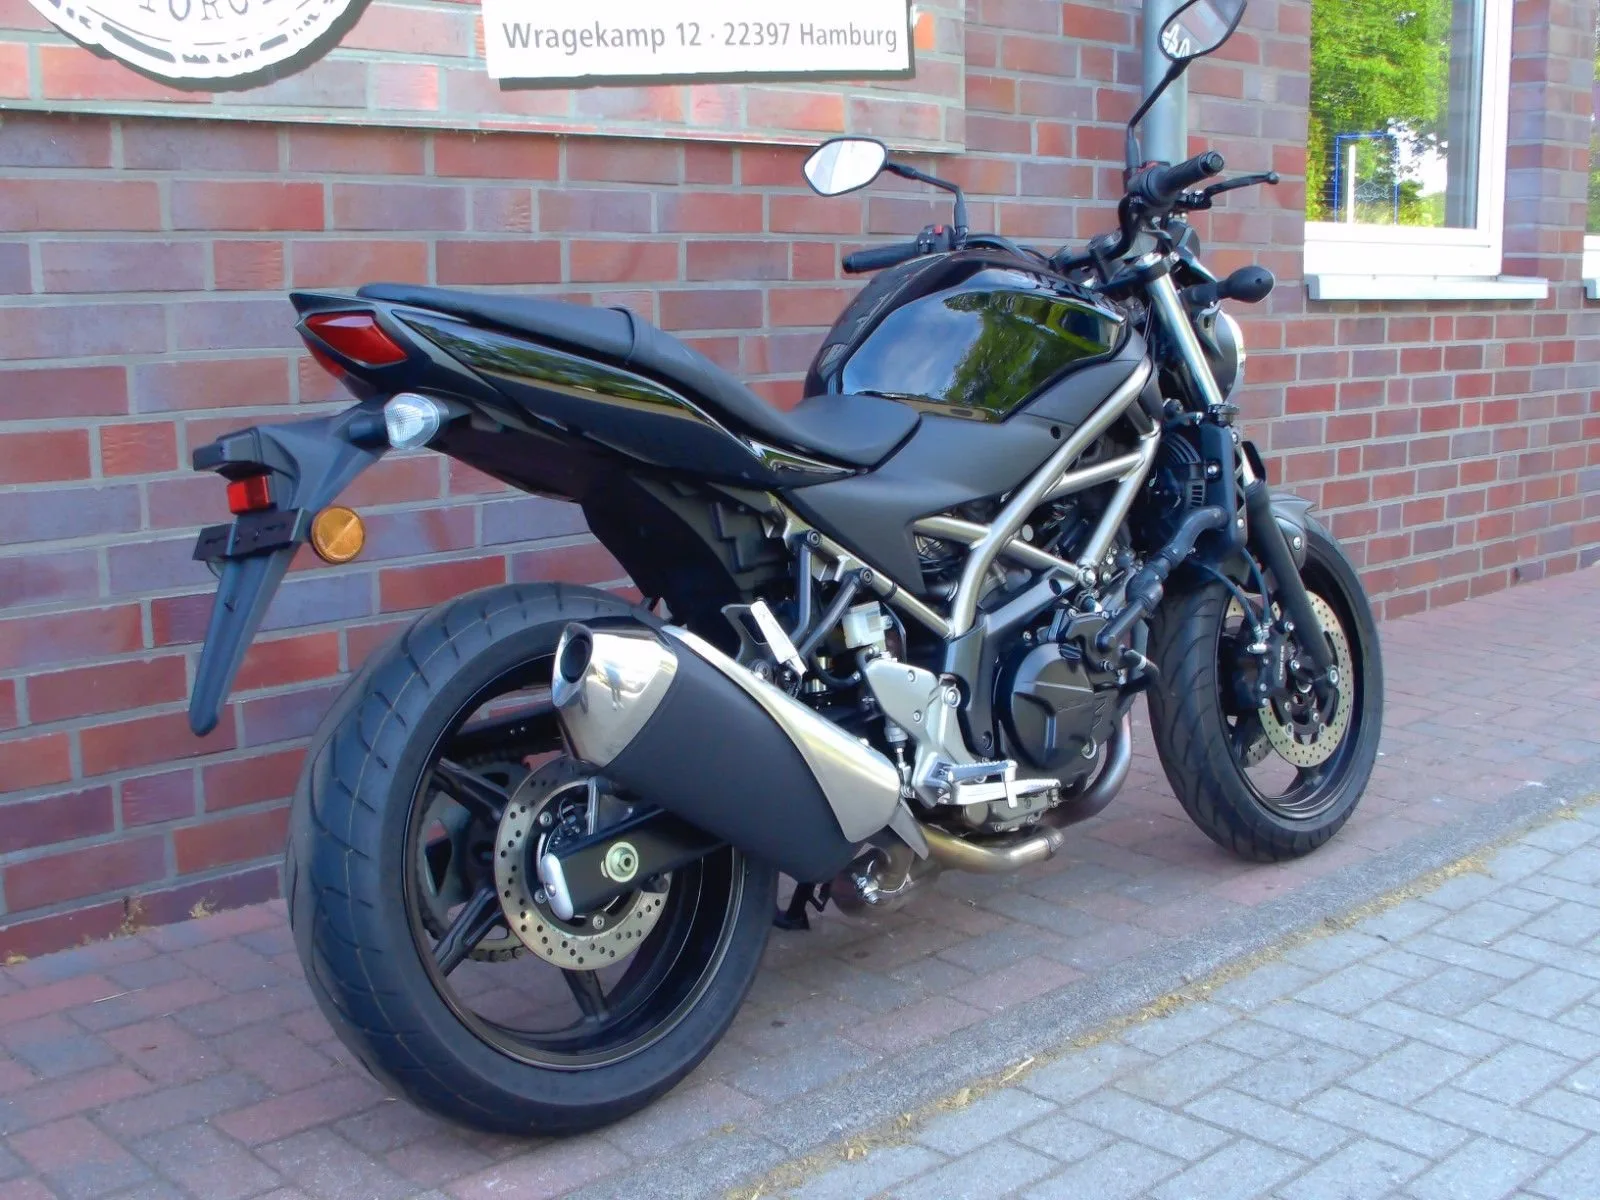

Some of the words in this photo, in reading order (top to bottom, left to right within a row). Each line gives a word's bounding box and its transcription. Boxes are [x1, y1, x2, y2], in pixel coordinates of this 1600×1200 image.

[502, 20, 666, 56] Wragekamp
[676, 22, 702, 46] 12
[723, 22, 790, 46] 22397
[800, 22, 897, 52] Hamburg
